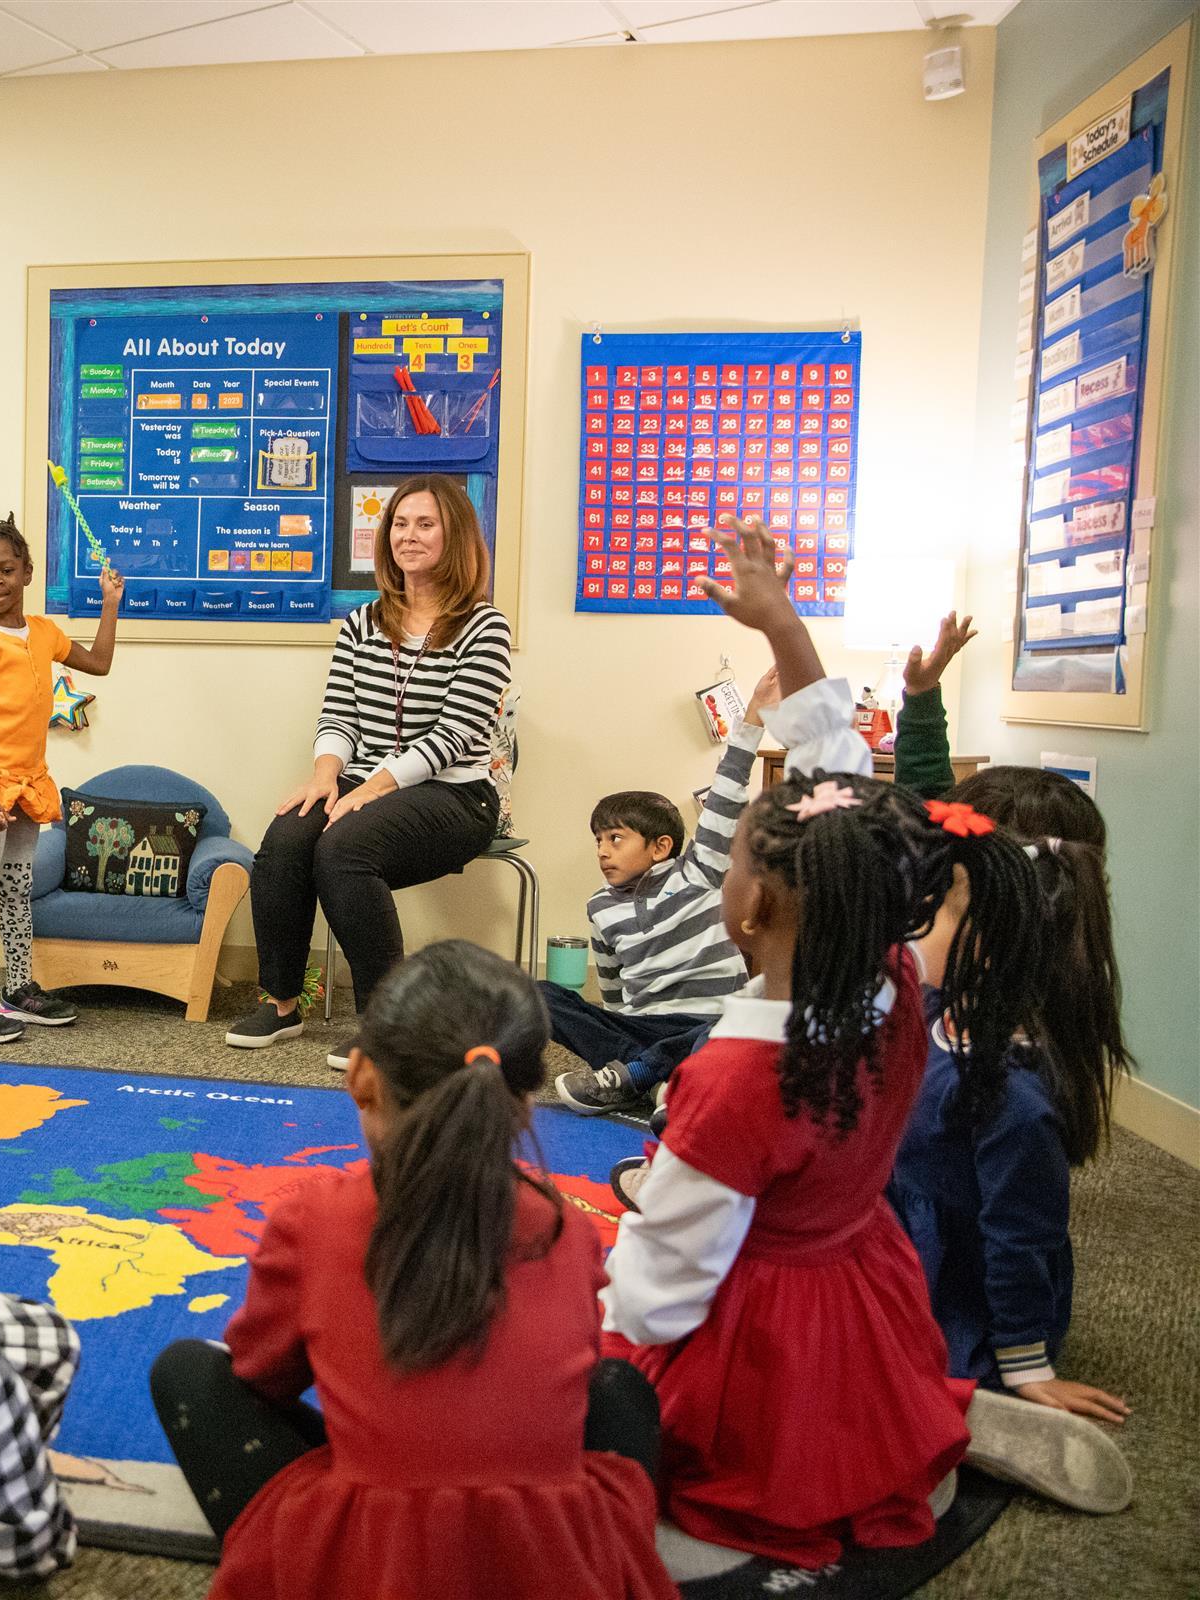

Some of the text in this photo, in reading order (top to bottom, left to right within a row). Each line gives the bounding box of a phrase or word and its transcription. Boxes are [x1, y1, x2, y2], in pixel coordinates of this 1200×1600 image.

[1086, 118, 1117, 146] Today's
[1083, 132, 1118, 163] Schedule
[395, 322, 449, 333] Let's Count
[123, 337, 286, 359] All About Today
[356, 342, 392, 350] Hundreds
[415, 341, 432, 350] Tens
[458, 341, 478, 350] Ones
[411, 354, 423, 370] 4
[459, 354, 471, 370] 3
[89, 368, 115, 377] Sunday
[595, 372, 599, 381] 1
[674, 372, 681, 380] 4
[755, 371, 762, 380] 7
[781, 371, 789, 380] 8
[810, 370, 817, 380] 9
[835, 370, 847, 379] 10
[150, 380, 175, 389] Month
[193, 380, 211, 388] Date
[223, 380, 240, 388] Year
[264, 379, 320, 388] Special Events
[89, 386, 117, 396] Monday
[223, 397, 240, 405] 2023
[620, 395, 631, 405] 12
[726, 395, 738, 404] 16
[779, 395, 790, 404] 18
[834, 394, 850, 404] 20
[140, 423, 182, 432] Yesterday
[592, 419, 601, 428] 21
[644, 419, 658, 429] 23
[669, 420, 684, 429] 24
[831, 419, 847, 429] 30
[200, 426, 229, 436] Tuesday
[259, 429, 320, 438] Pick-A-Question
[86, 441, 117, 450] Thursday
[616, 444, 629, 453] 32
[156, 448, 181, 457] Today
[90, 460, 114, 469] Friday
[173, 457, 181, 465] is
[138, 473, 180, 481] Tomorrow
[86, 478, 117, 487] Saturday
[152, 482, 180, 490] will be
[590, 490, 601, 499] 51
[616, 491, 629, 500] 52
[119, 500, 161, 511] Weather
[243, 502, 280, 512] Season
[615, 514, 629, 524] 62
[110, 525, 142, 535] Today is
[216, 526, 231, 534] The
[263, 527, 271, 535] is
[133, 539, 141, 547] W
[152, 539, 161, 547] Th
[589, 537, 599, 545] 71
[589, 584, 599, 592] 91
[612, 584, 625, 593] 92
[798, 586, 813, 595] 99
[129, 599, 149, 607] Dates
[166, 599, 187, 607] Years
[202, 601, 234, 609] Weather
[248, 601, 275, 609] Season
[289, 600, 315, 609] Events
[116, 1084, 294, 1106] Arctic Ocean
[103, 1183, 186, 1199] Europe
[48, 1234, 122, 1251] Africa
